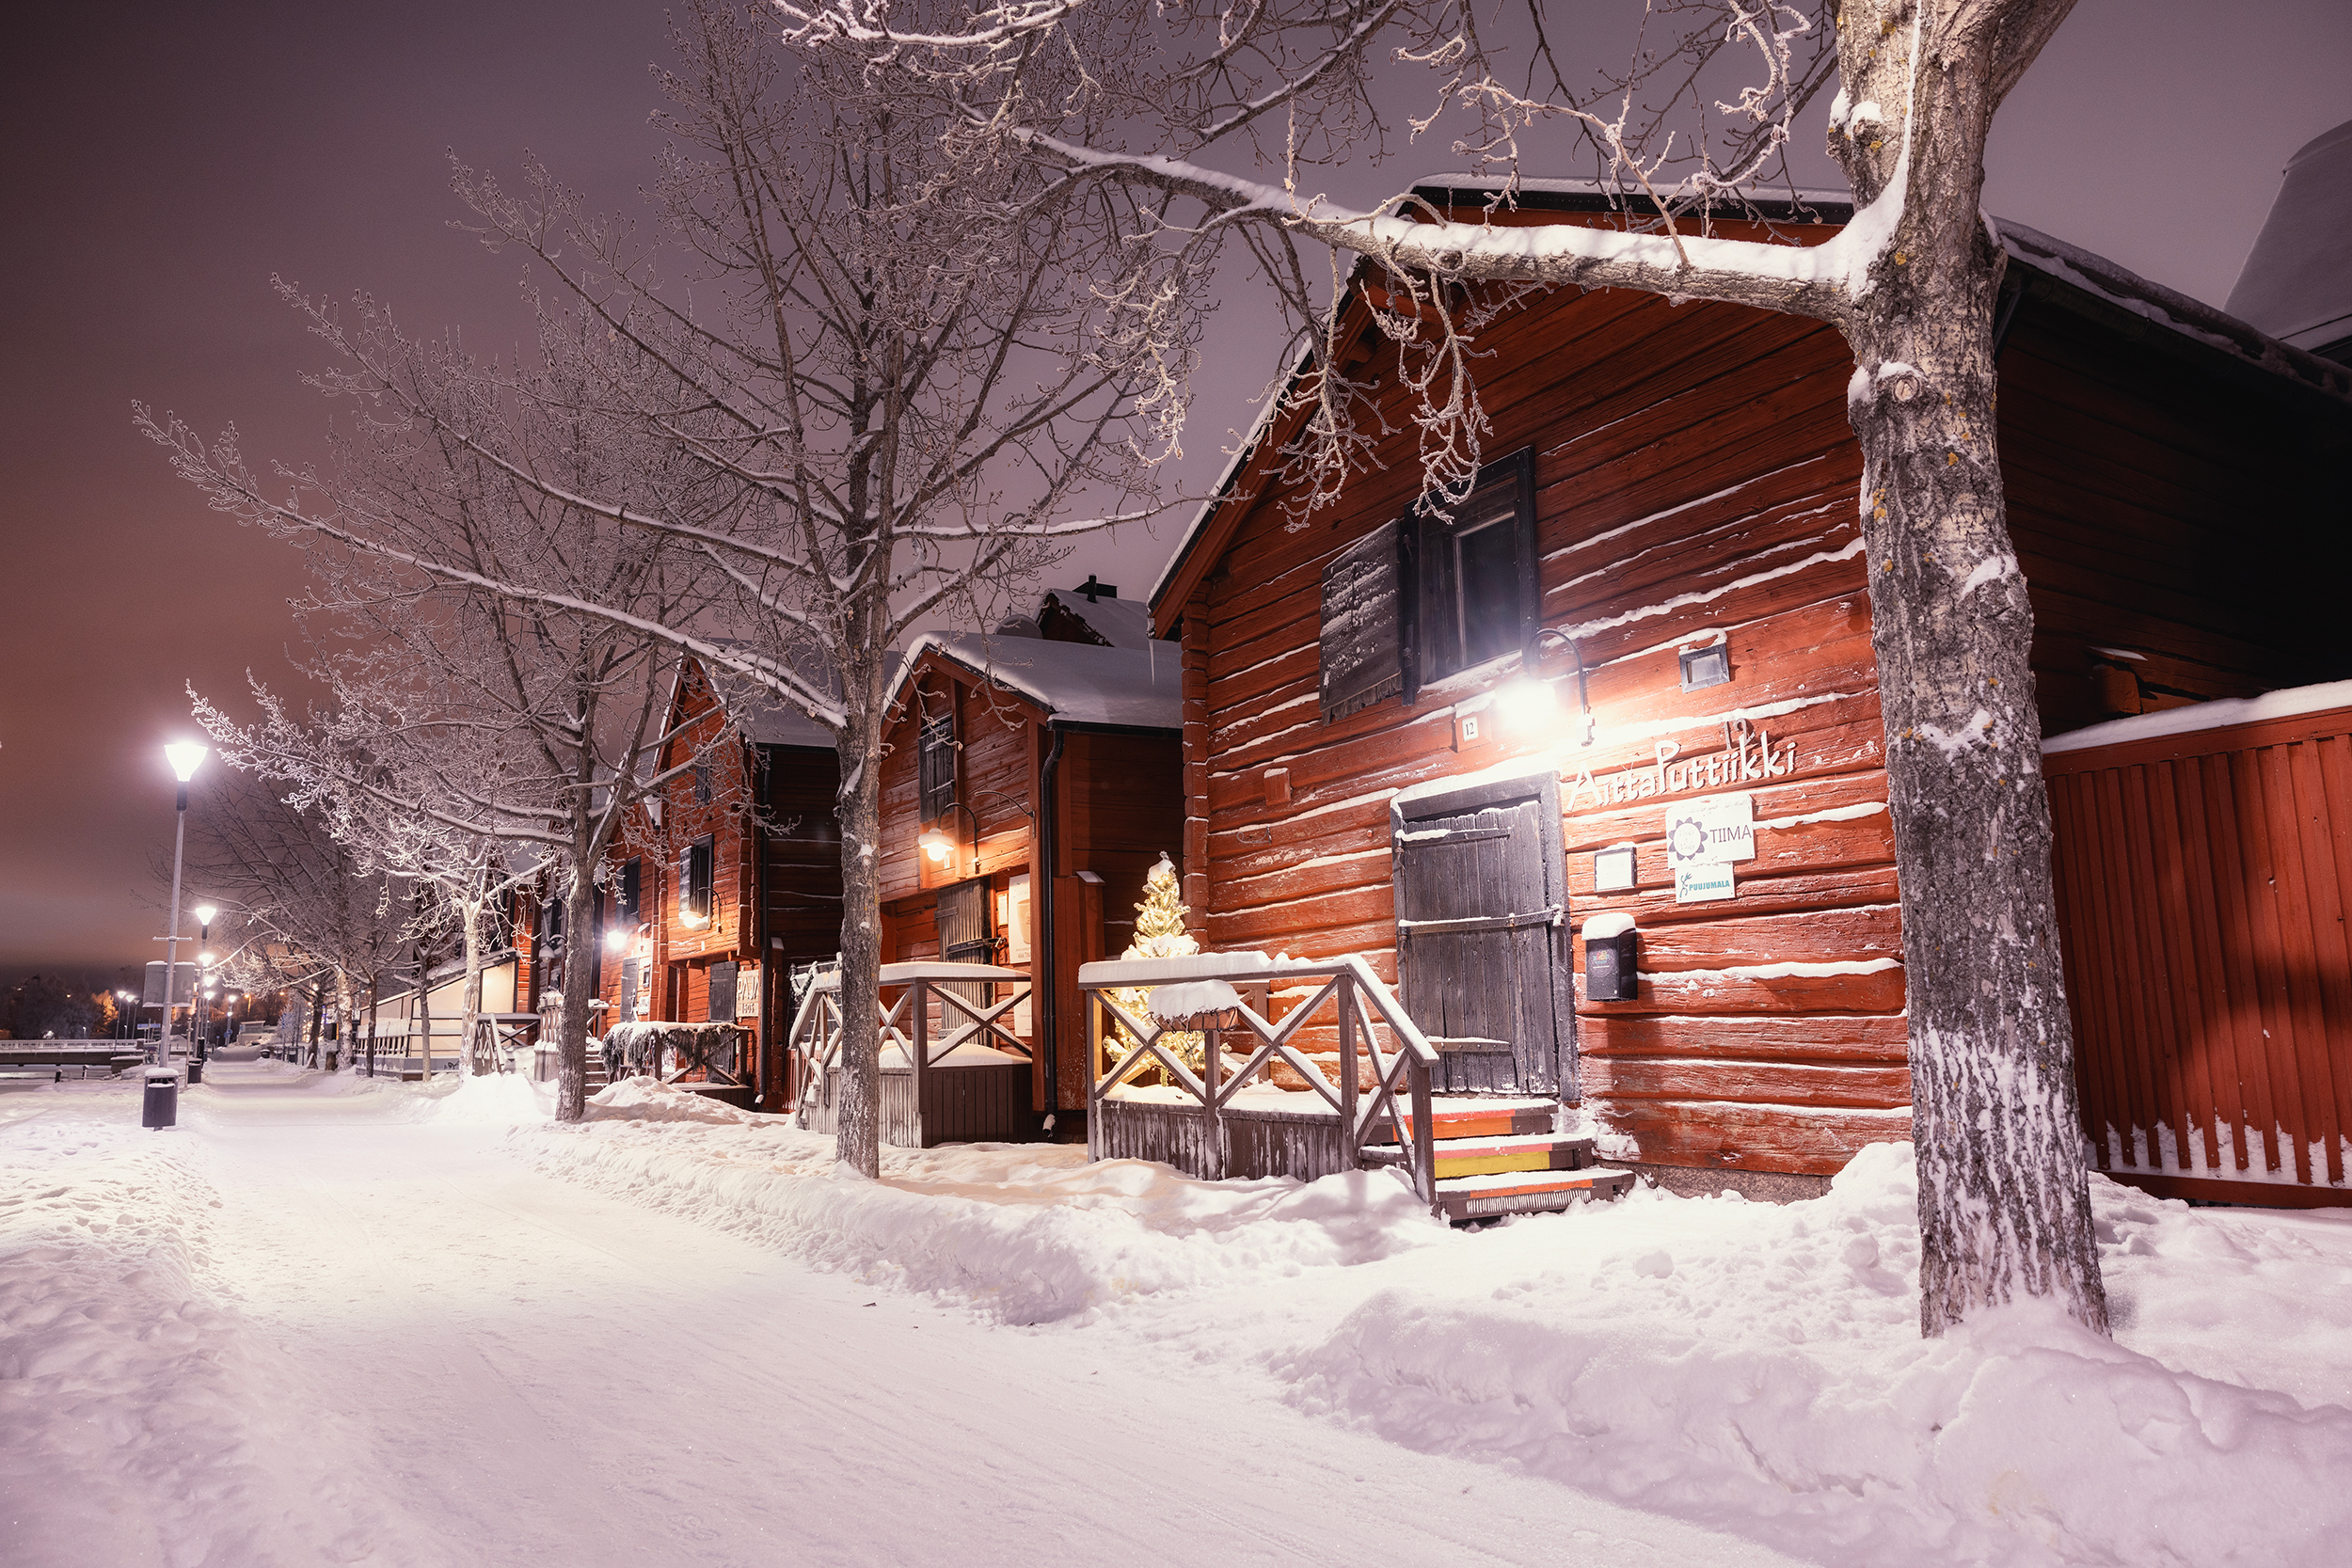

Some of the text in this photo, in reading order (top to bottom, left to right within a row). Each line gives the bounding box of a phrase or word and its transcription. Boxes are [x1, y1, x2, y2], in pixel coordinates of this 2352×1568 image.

[1465, 721, 1474, 736] 12
[1722, 718, 1756, 751] 12
[1709, 824, 1752, 844] TIIMA
[1689, 879, 1730, 892] PUUJUMALA
